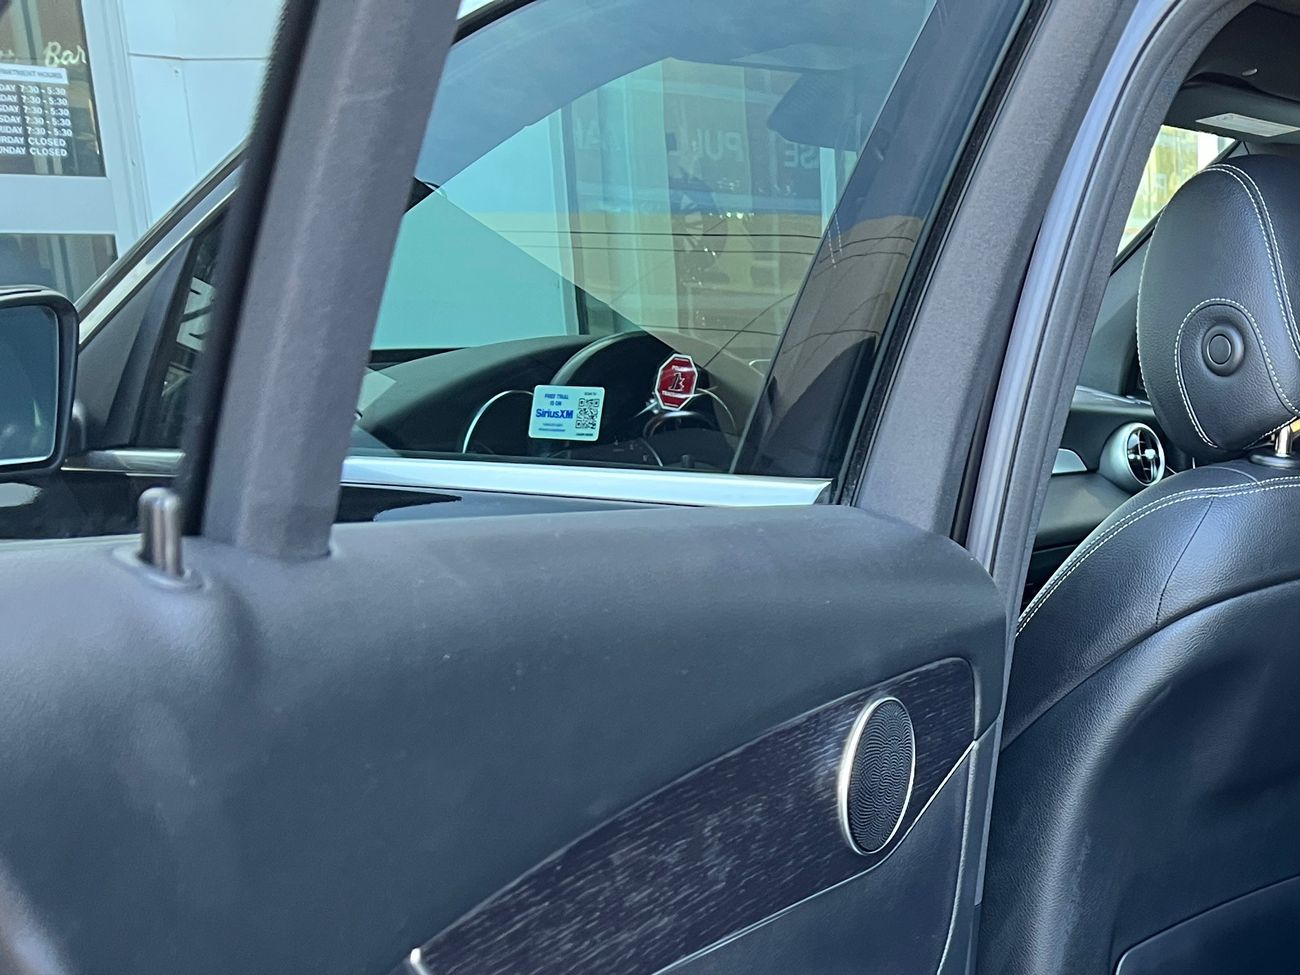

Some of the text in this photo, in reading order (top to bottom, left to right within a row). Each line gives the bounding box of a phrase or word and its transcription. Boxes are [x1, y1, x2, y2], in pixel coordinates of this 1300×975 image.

[0, 84, 16, 92] DAY
[20, 84, 39, 94] 7:30
[46, 87, 66, 95] 5:30
[0, 94, 18, 103] DAY
[21, 95, 41, 104] 7:30
[48, 97, 68, 106] 5:30
[23, 105, 43, 114] 7:30
[50, 107, 70, 116] 5:30
[25, 116, 44, 125] 7:30
[52, 118, 71, 127] 5:30
[26, 126, 46, 135] 7:30
[53, 128, 73, 137] 5:30
[28, 137, 66, 146] CLOSED
[30, 147, 67, 157] CLOSED
[535, 408, 574, 419] SiriusXM
